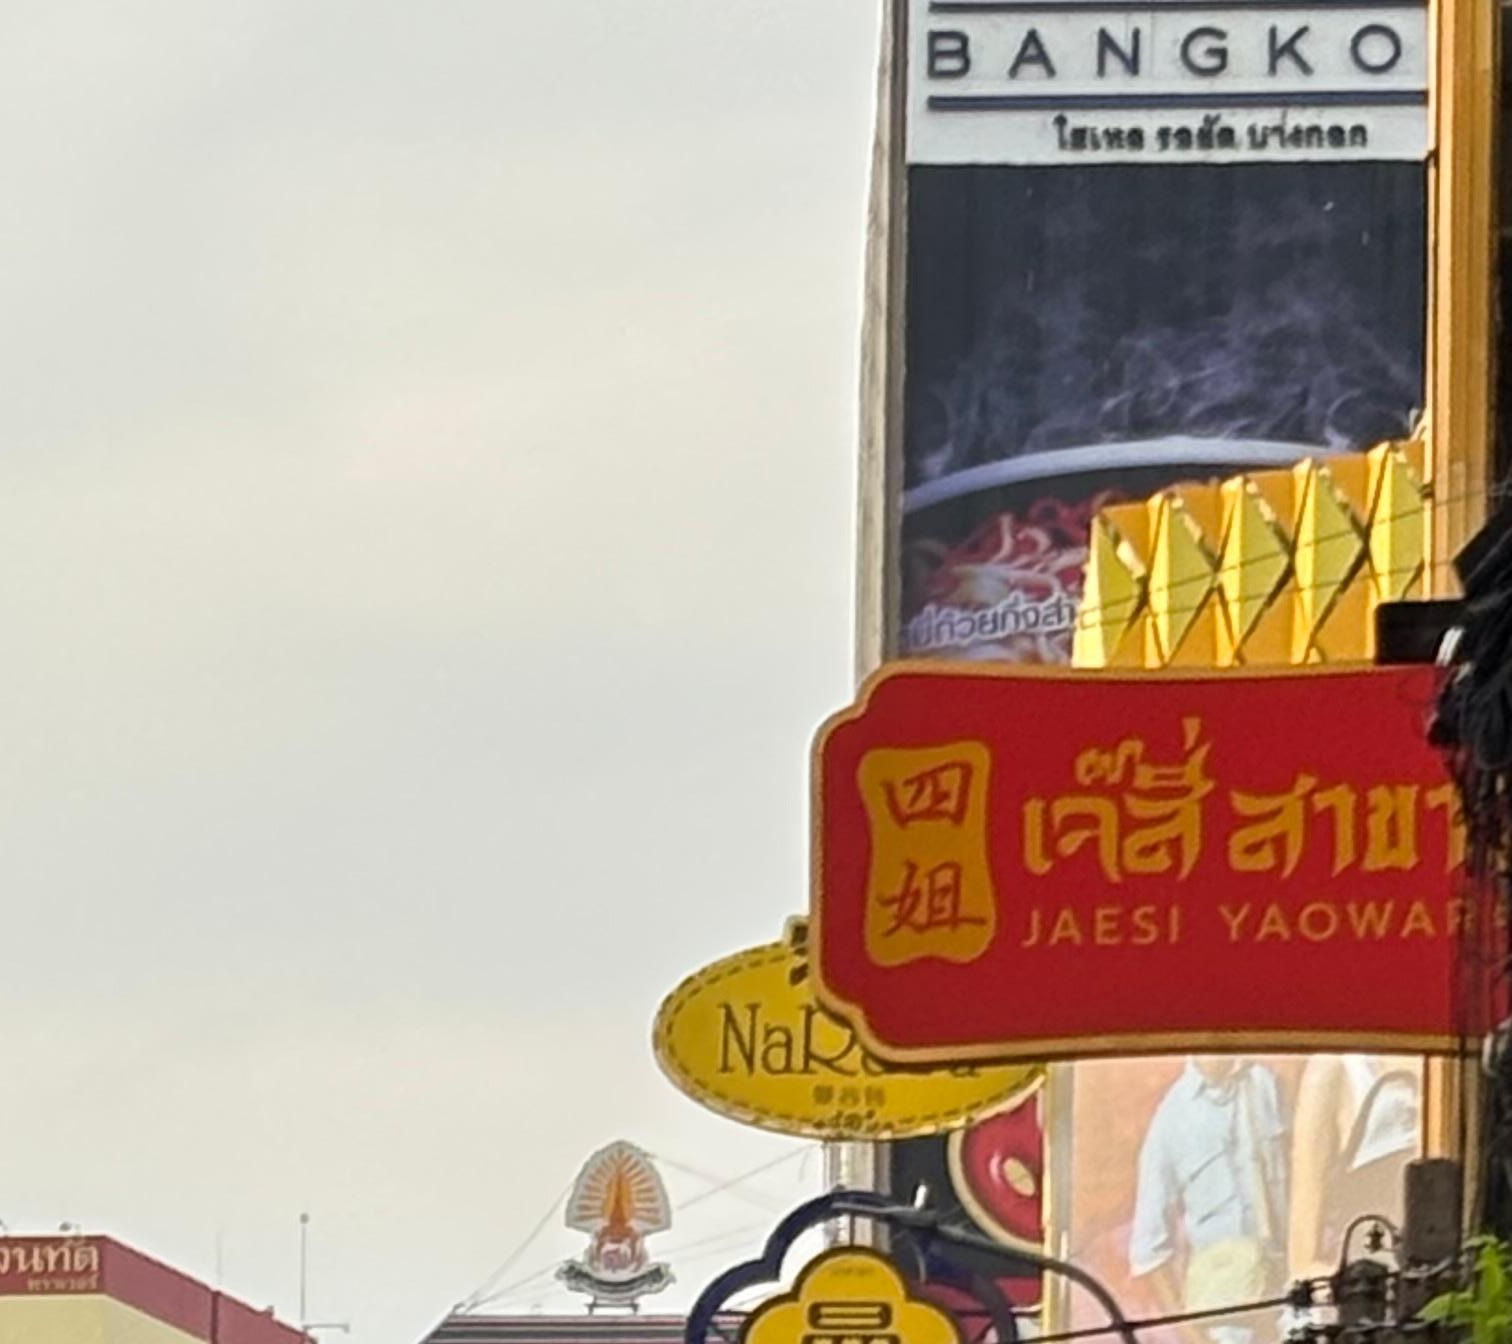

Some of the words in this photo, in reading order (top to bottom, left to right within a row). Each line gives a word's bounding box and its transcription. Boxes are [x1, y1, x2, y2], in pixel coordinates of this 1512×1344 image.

[925, 25, 1402, 79] BANGKO
[1021, 906, 1180, 947] JAESI
[716, 1003, 982, 1078] NaR
